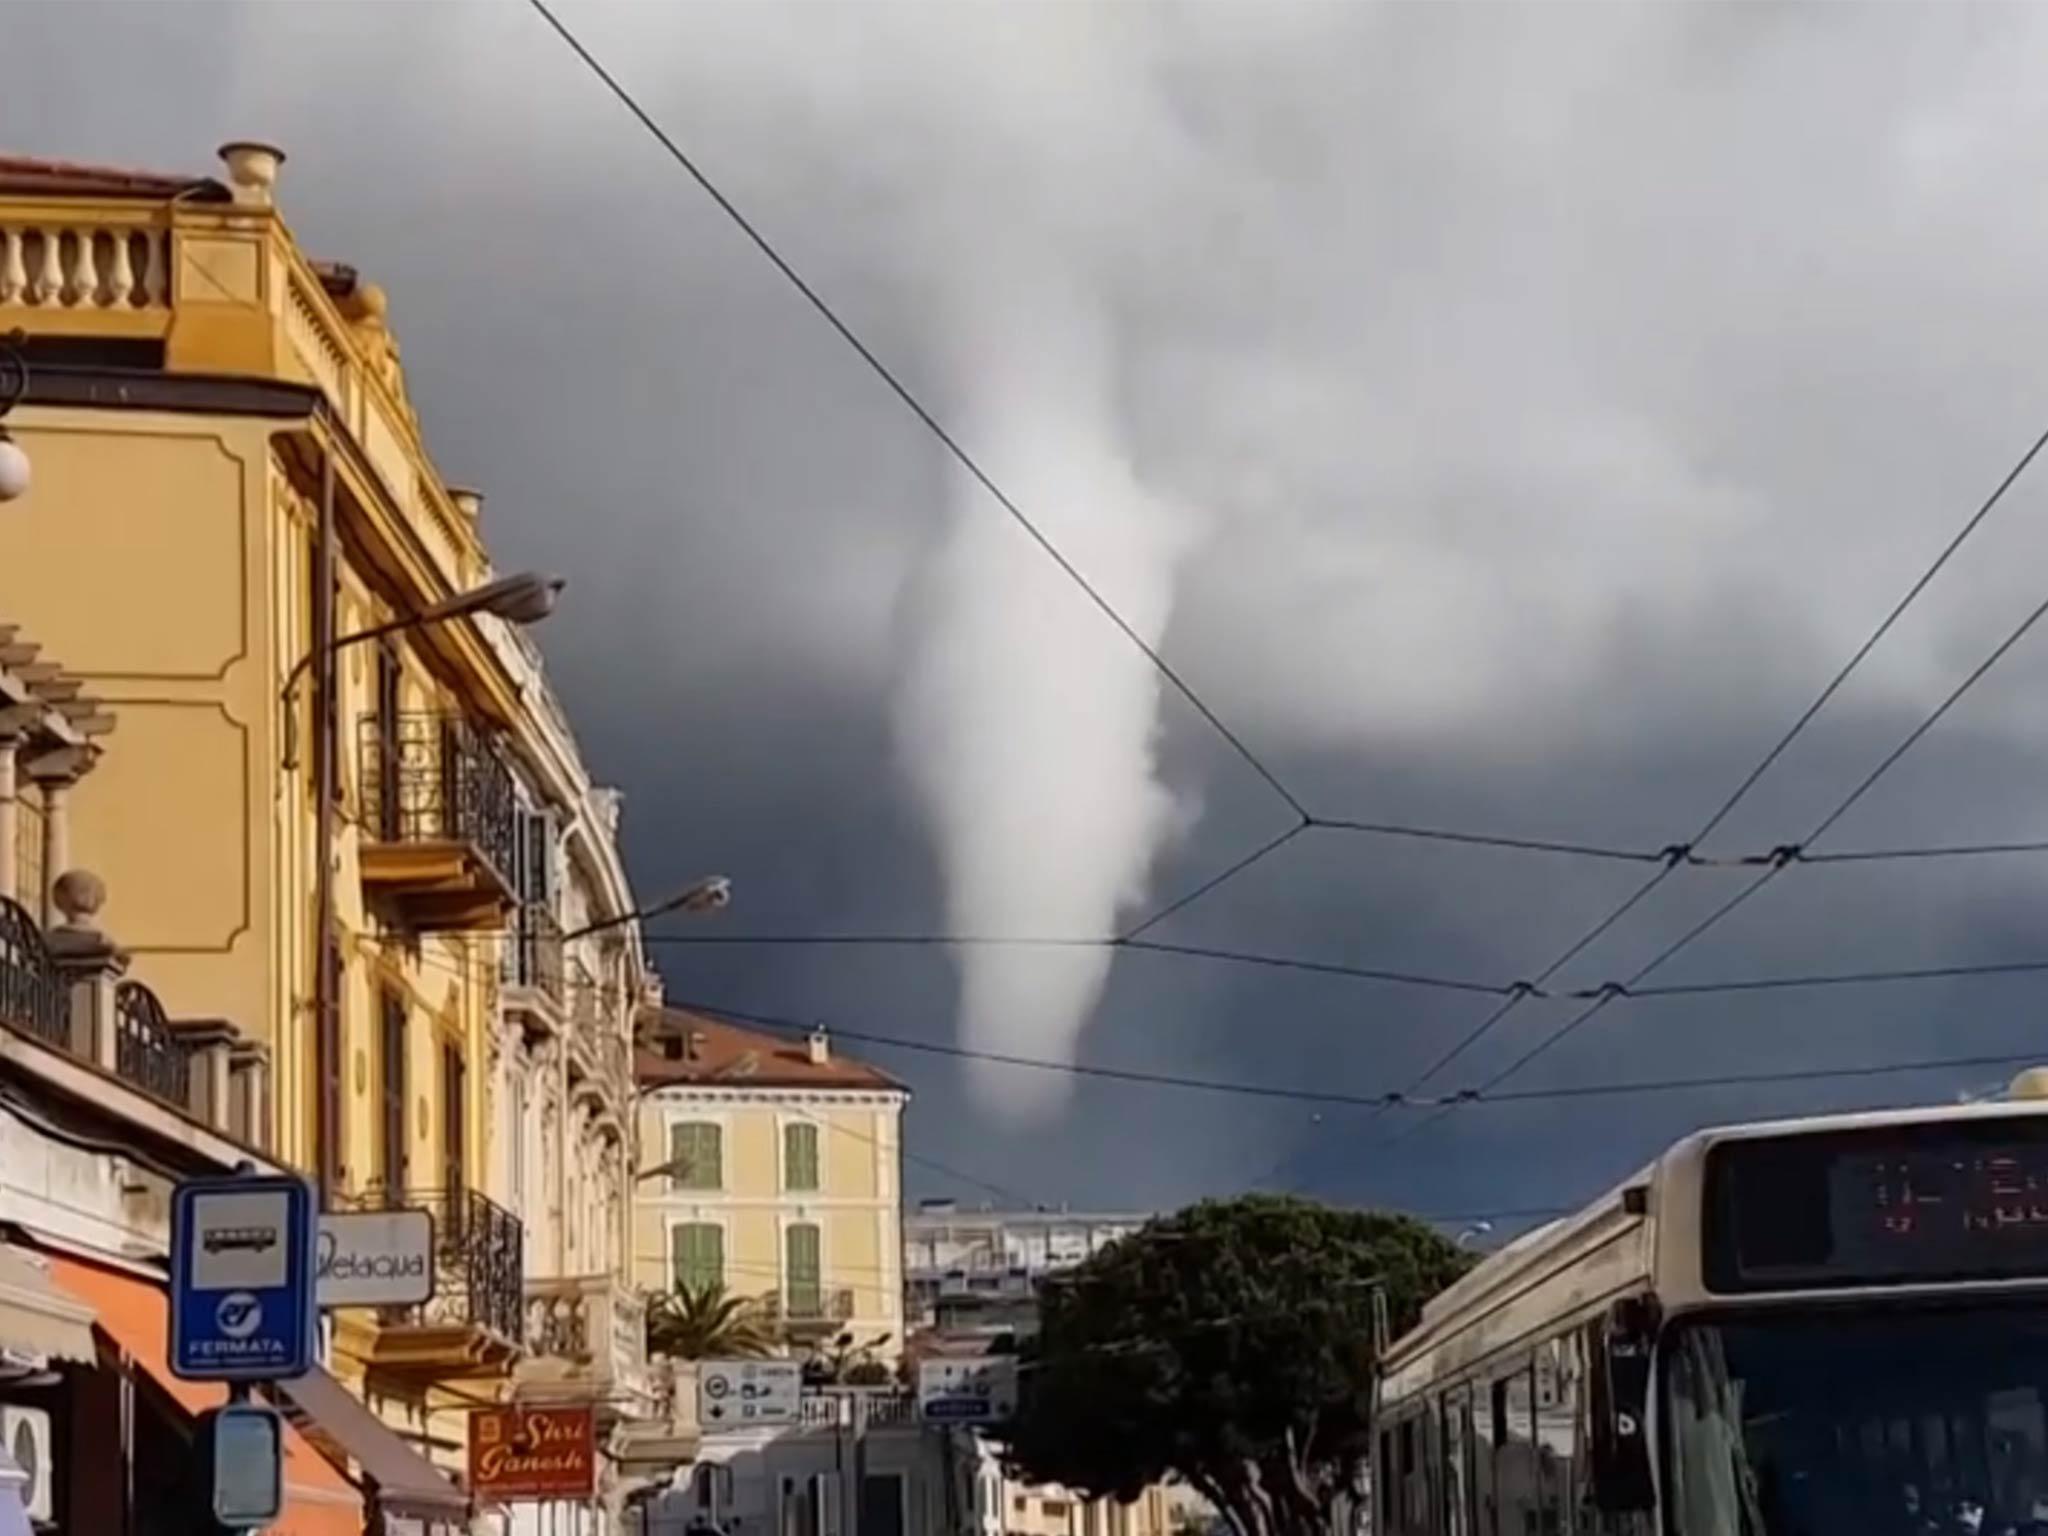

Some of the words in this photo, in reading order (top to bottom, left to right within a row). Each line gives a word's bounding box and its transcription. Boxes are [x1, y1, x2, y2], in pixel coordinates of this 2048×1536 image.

[188, 1339, 284, 1356] FERMATA
[515, 1413, 584, 1450] Shri
[477, 1444, 584, 1480] Ganesh
